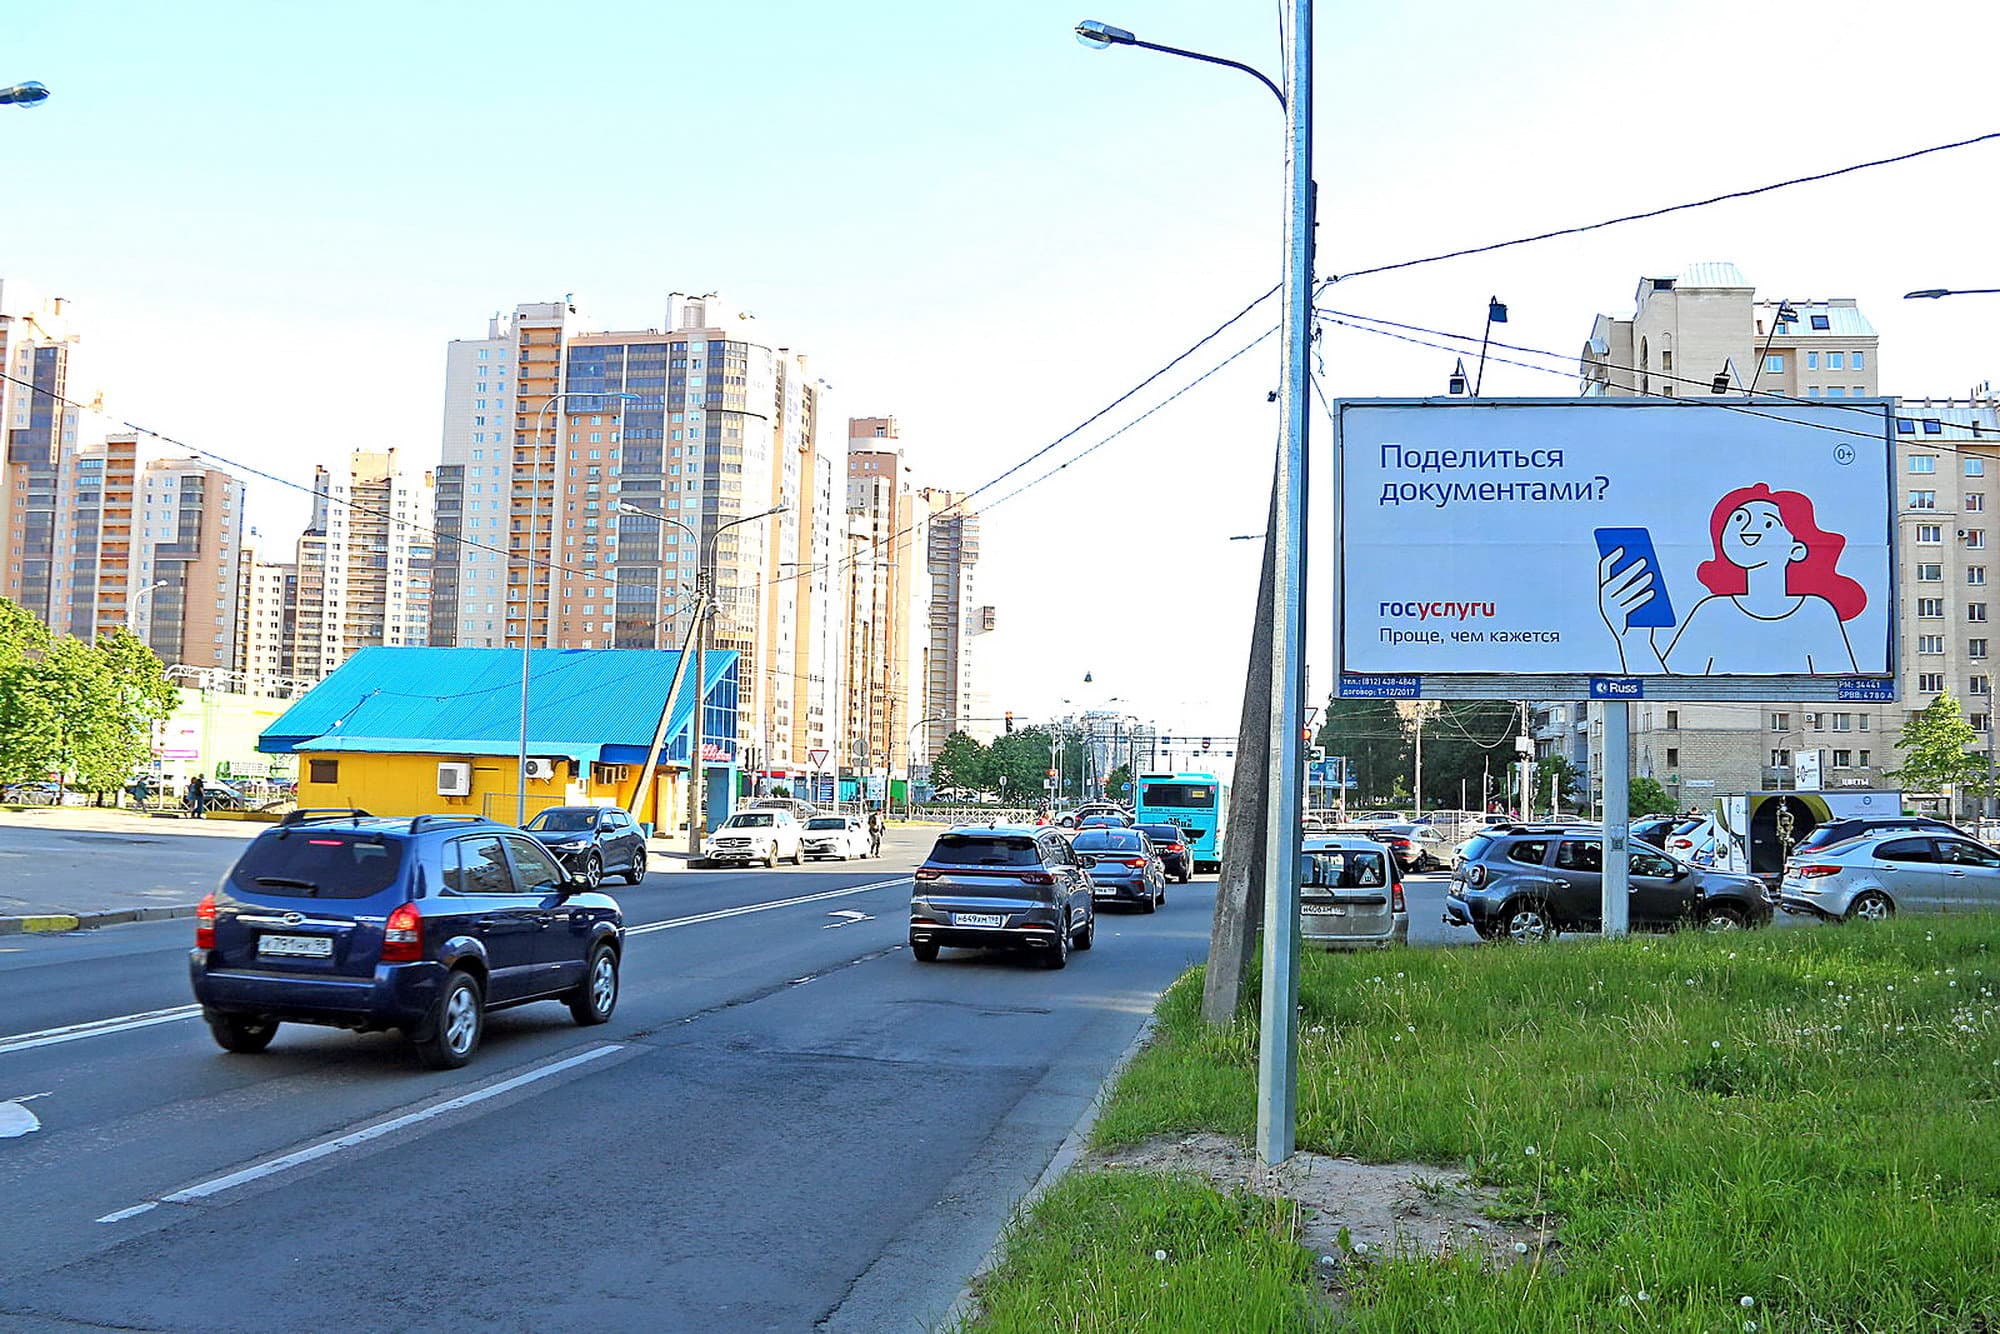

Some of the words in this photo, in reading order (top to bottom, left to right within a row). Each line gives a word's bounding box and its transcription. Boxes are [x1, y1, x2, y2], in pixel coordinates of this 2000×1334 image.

[1381, 444, 1564, 473] Поделиться
[1380, 476, 1610, 508] документами?
[1380, 602, 1495, 621] госуслуги
[1380, 628, 1445, 645] Проще,
[1450, 631, 1484, 642] чем
[1490, 631, 1560, 642] кажется
[1362, 678, 1381, 686] (812)
[1609, 682, 1638, 693] Russ
